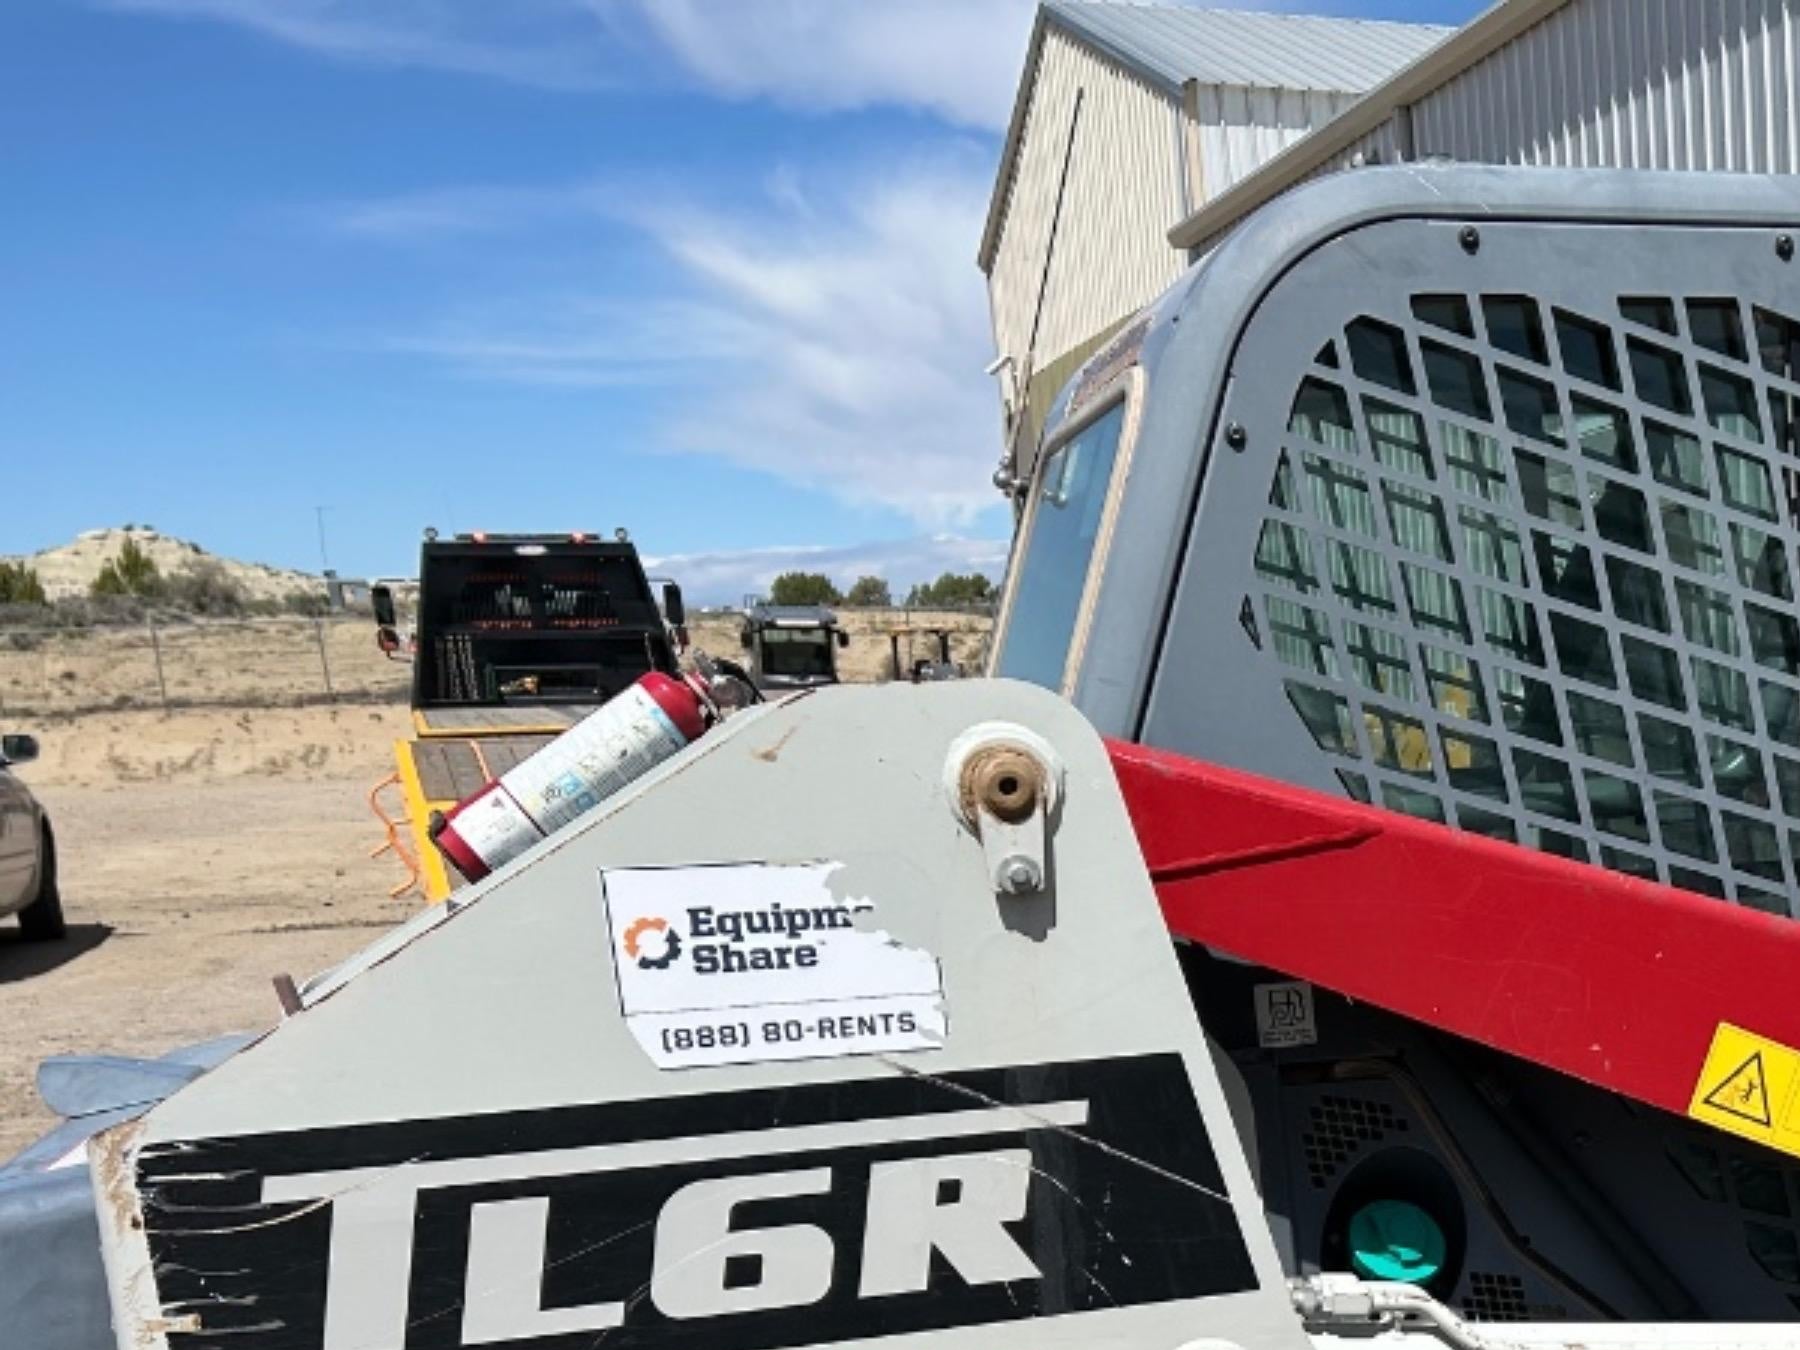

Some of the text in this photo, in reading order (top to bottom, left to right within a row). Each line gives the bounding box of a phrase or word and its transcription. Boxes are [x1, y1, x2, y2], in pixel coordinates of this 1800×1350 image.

[686, 902, 874, 942] Equipm
[692, 943, 819, 974] Share
[762, 1010, 917, 1043] 80-RENTS
